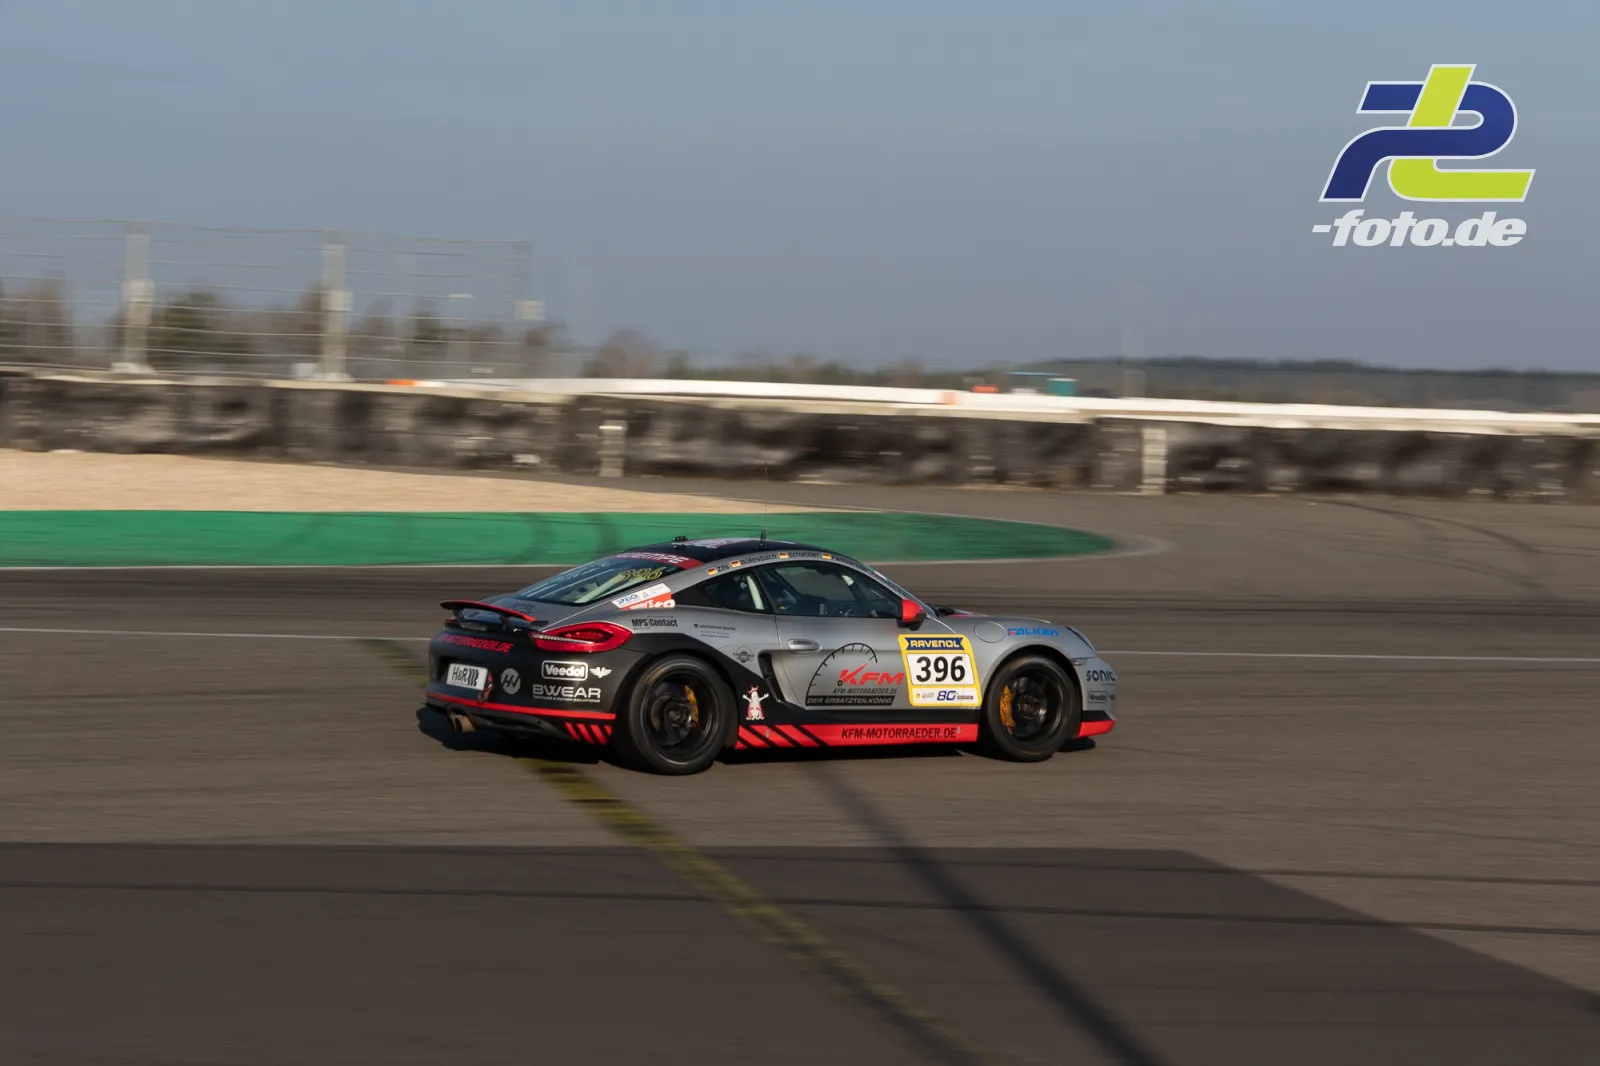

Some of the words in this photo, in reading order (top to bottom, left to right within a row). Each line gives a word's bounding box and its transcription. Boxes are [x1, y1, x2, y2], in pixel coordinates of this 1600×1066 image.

[631, 618, 648, 627] MPS
[1007, 628, 1059, 637] FALKEN
[910, 639, 960, 648] RAVENOL
[544, 664, 586, 678] Veedol
[839, 663, 905, 685] KFM
[916, 656, 966, 682] 396
[532, 684, 602, 699] BWEAR
[832, 687, 898, 695] KFM-MOTORRAEDER.DE
[841, 727, 957, 739] KFM-MOTORRAEDER.DE
